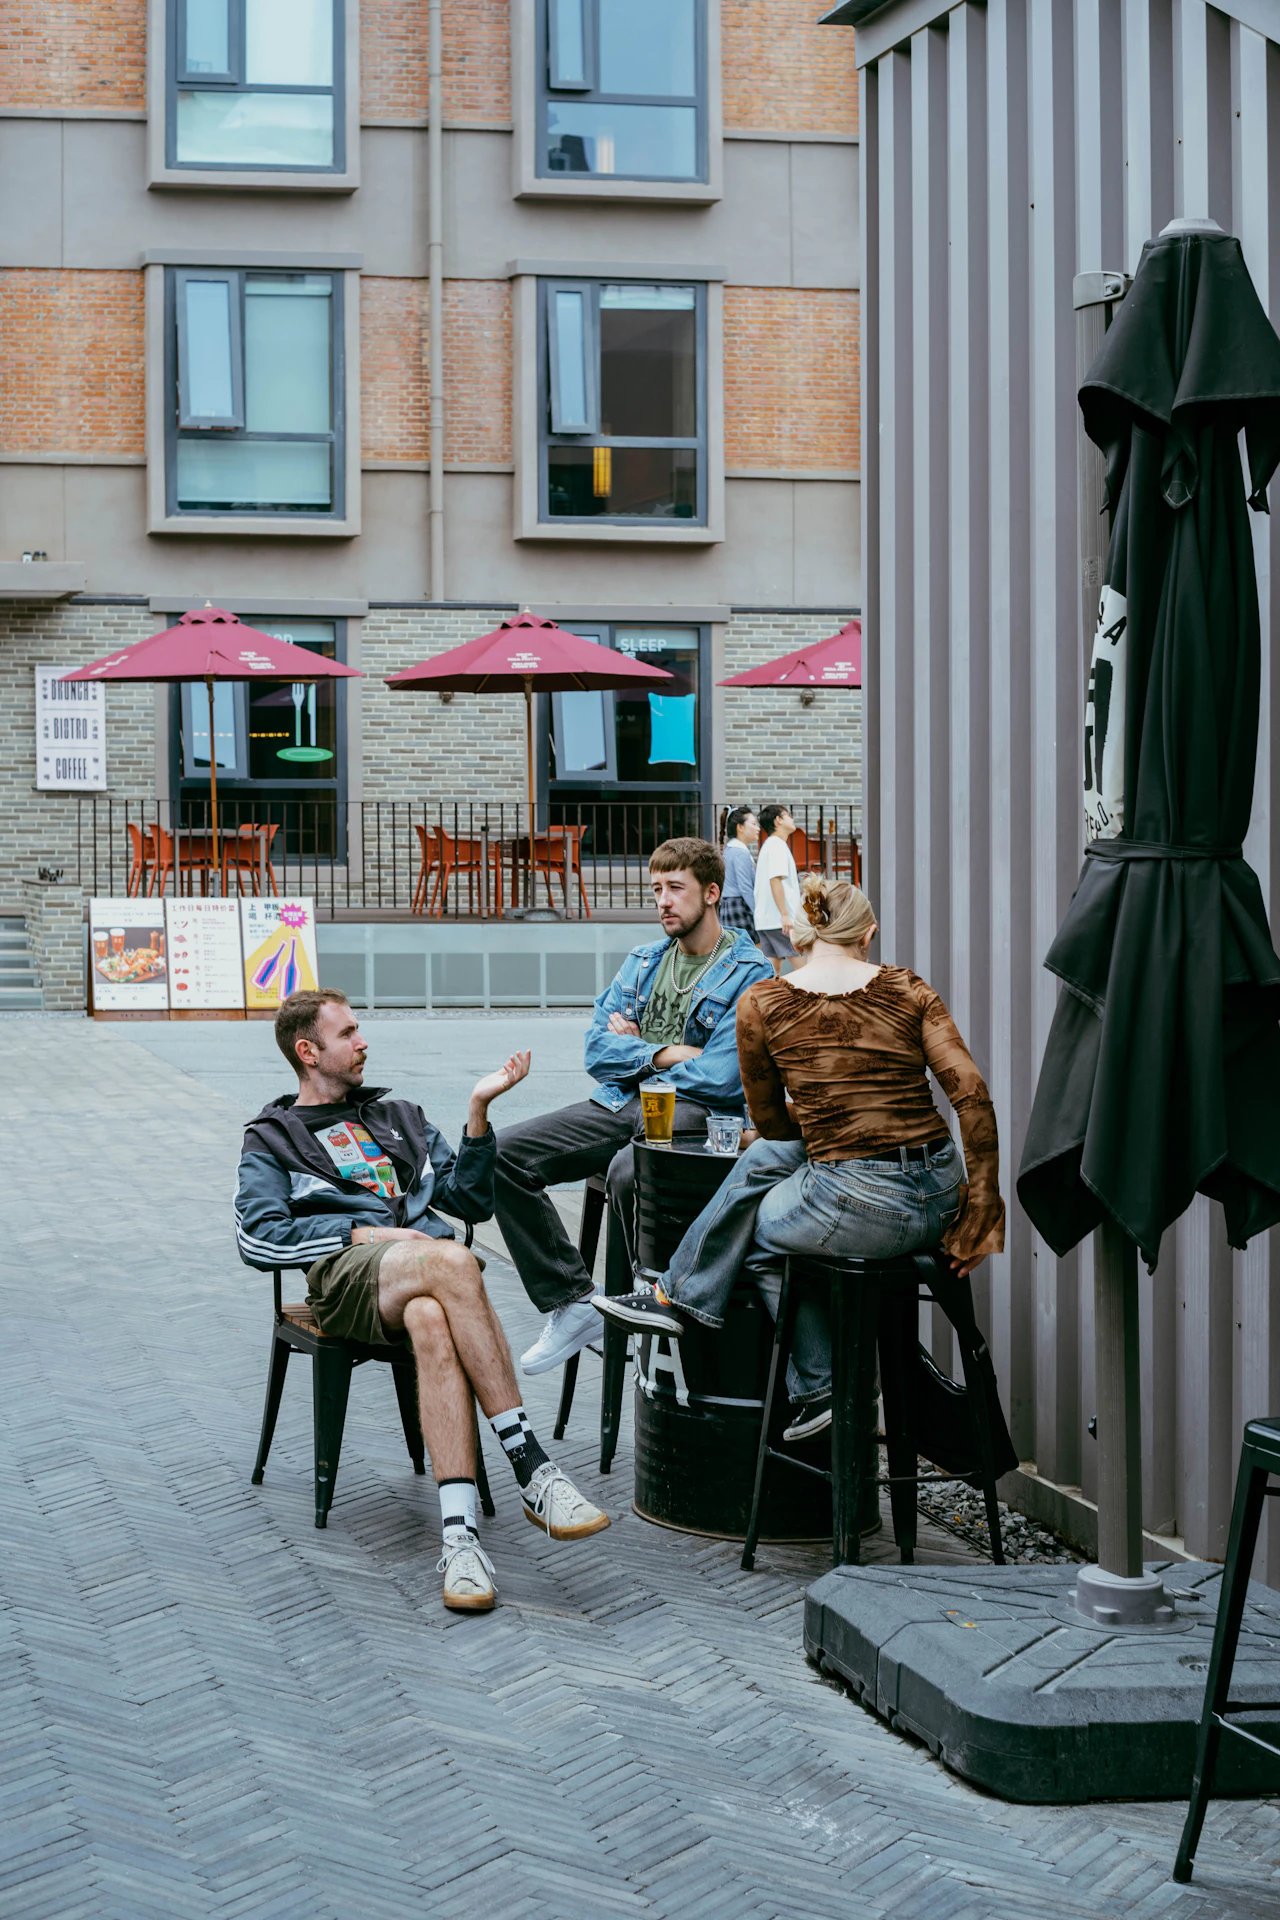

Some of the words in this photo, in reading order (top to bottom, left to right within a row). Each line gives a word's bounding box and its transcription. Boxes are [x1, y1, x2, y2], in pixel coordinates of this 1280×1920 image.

[620, 638, 667, 653] SLEEP
[51, 678, 89, 701] BRUNCH
[53, 717, 88, 740] BISTRO
[55, 757, 87, 780] COFFEE
